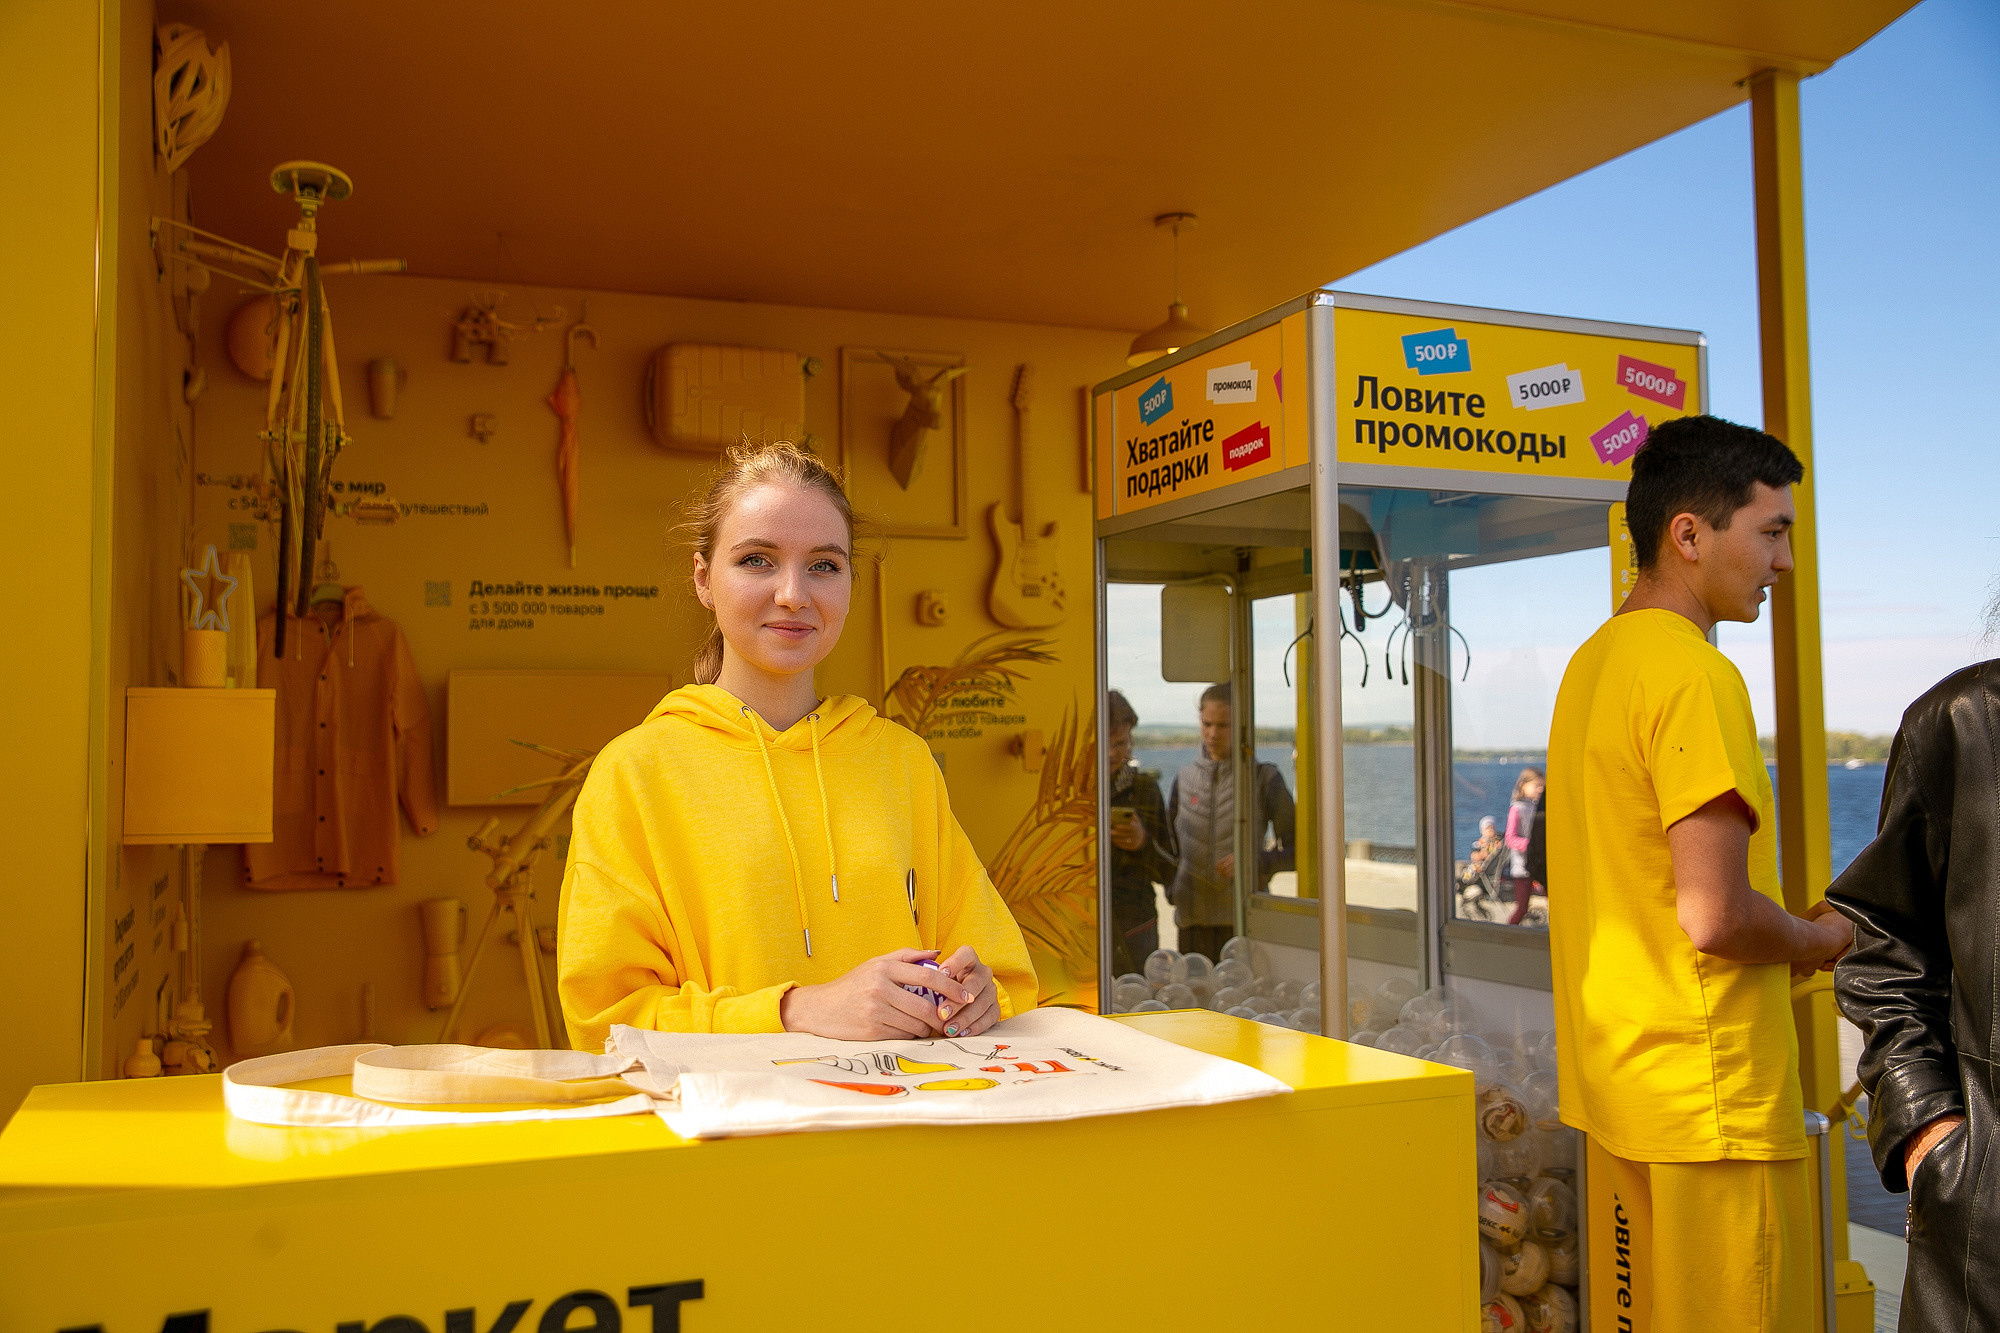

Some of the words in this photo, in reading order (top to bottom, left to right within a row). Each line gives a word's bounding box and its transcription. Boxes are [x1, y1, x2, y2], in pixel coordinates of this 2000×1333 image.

[1415, 343, 1458, 362] 500₽
[1213, 379, 1252, 394] промокод
[1354, 375, 1486, 418] Ловите
[1144, 389, 1167, 415] 500₽
[1126, 418, 1214, 469] Хватайте
[1229, 437, 1264, 459] подарок
[1355, 419, 1567, 463] промокоды
[1602, 423, 1639, 455] 500₽
[1127, 452, 1209, 498] подарки
[469, 580, 544, 598] Делайте
[547, 583, 601, 597] жизнь
[603, 584, 660, 599] проще
[550, 603, 605, 617] товаров
[469, 618, 495, 631] для
[498, 618, 535, 631] дома
[1614, 1193, 1632, 1308] овите
